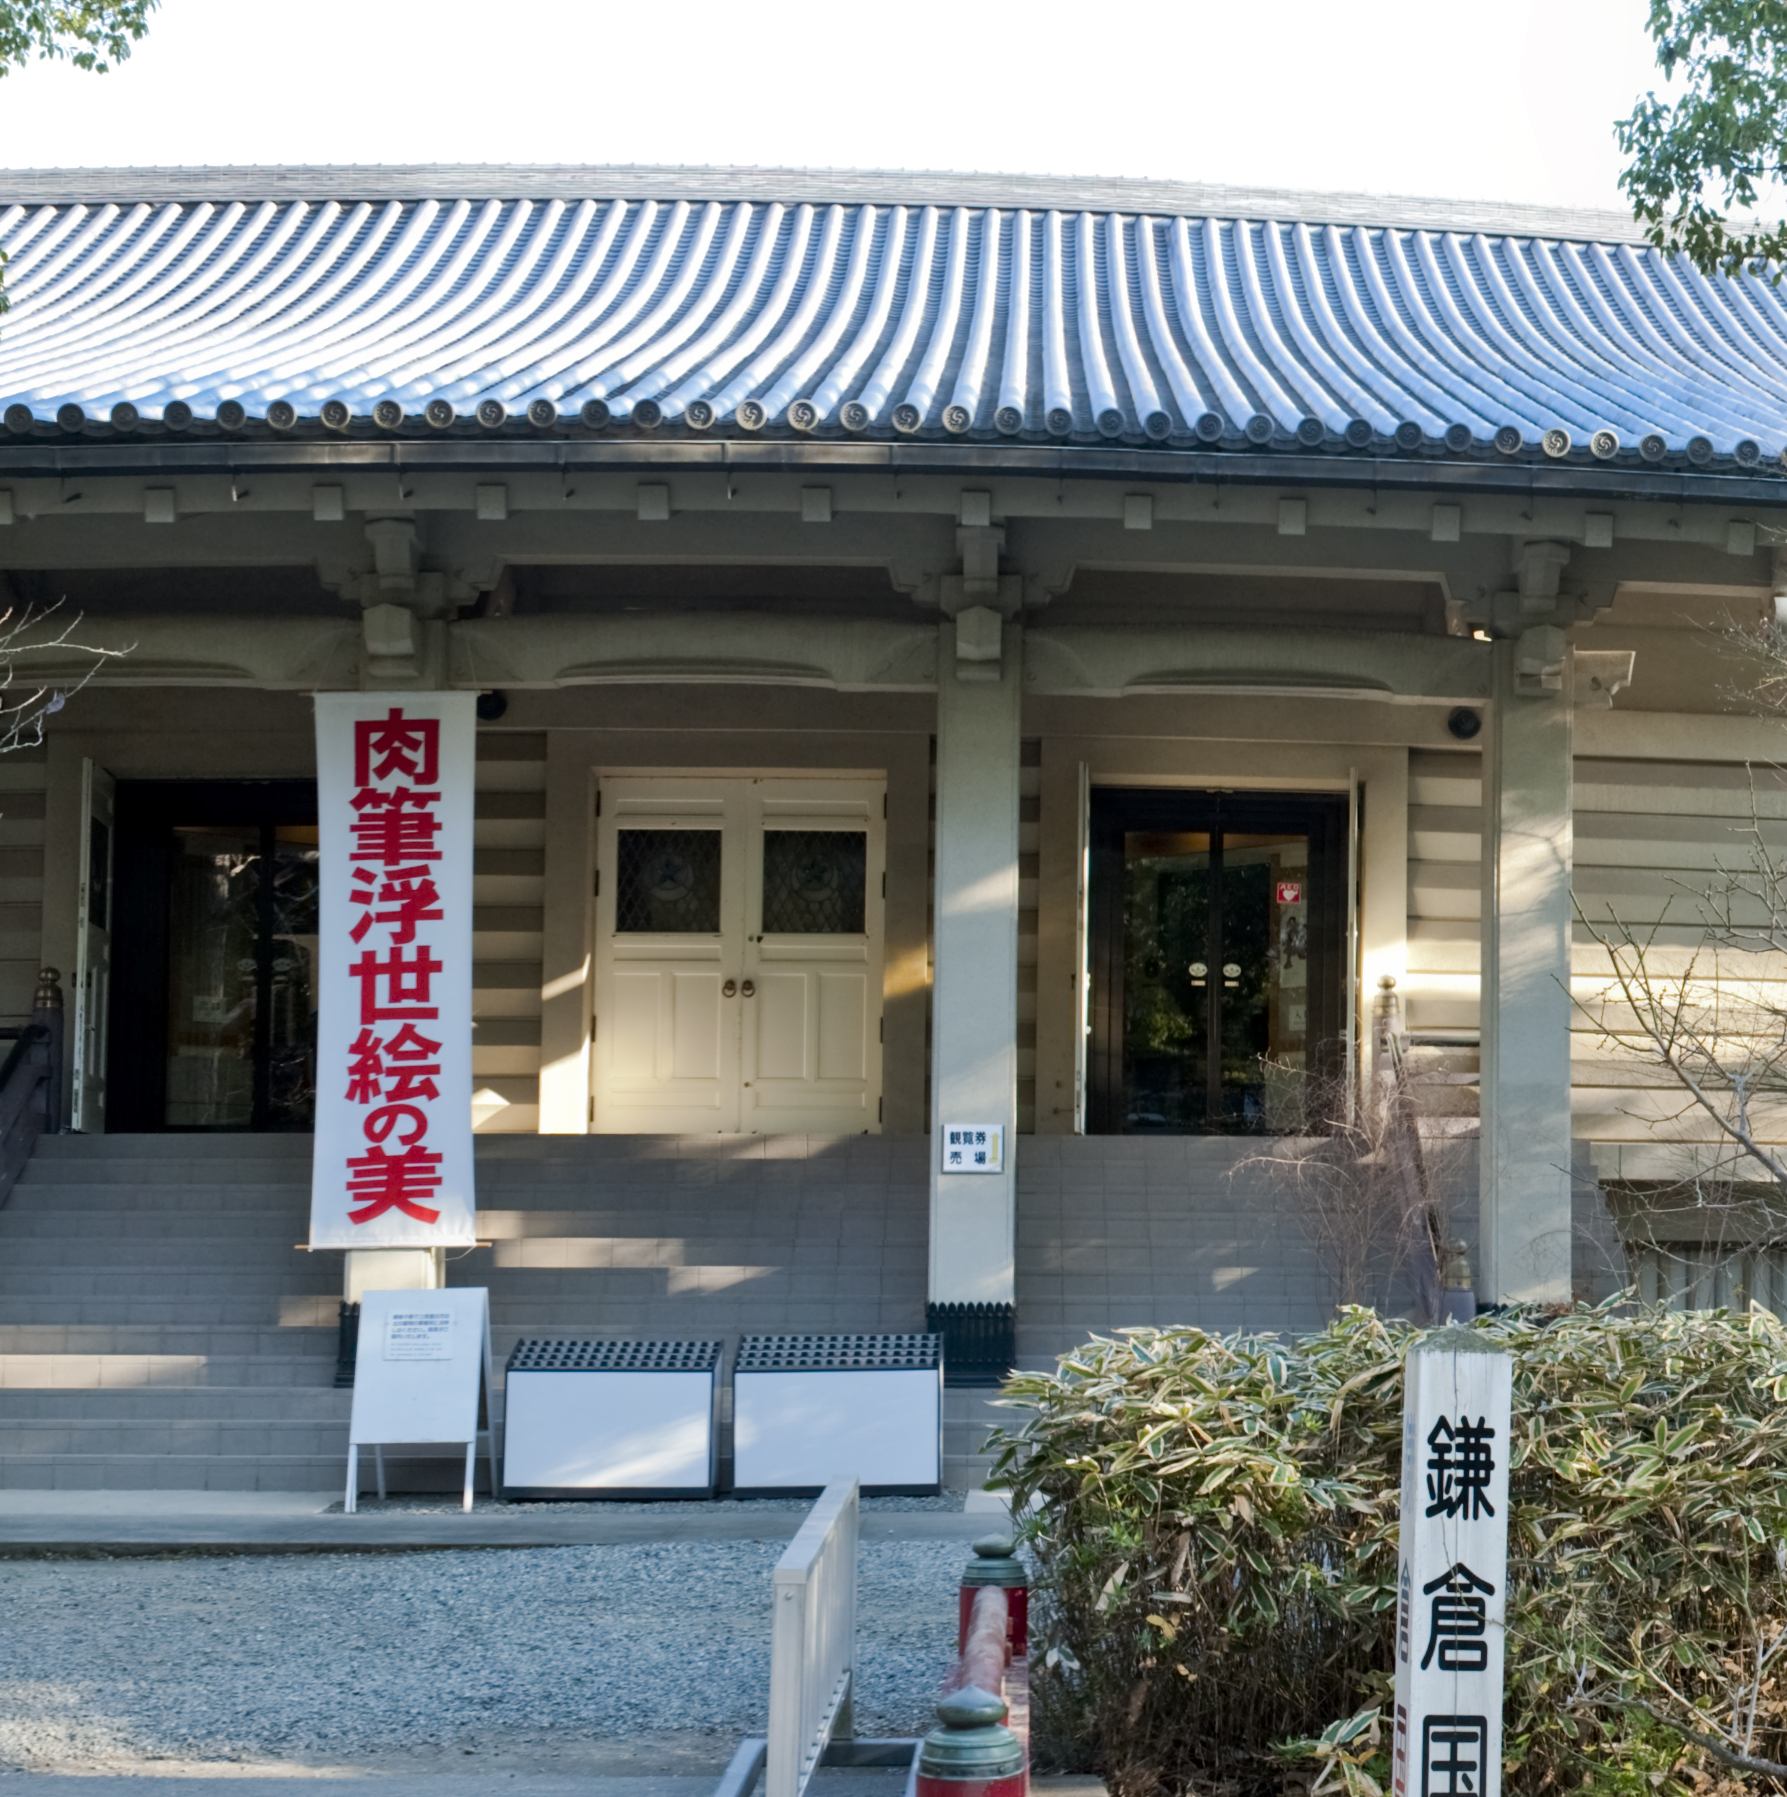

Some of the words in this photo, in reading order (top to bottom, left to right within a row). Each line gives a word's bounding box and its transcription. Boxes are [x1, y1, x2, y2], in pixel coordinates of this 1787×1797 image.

[344, 707, 444, 1226] 肉筆浮世絵の美
[950, 1131, 986, 1145] 観覧券
[950, 1151, 986, 1165] 売場
[1421, 1415, 1495, 1797] 鎌倉国
